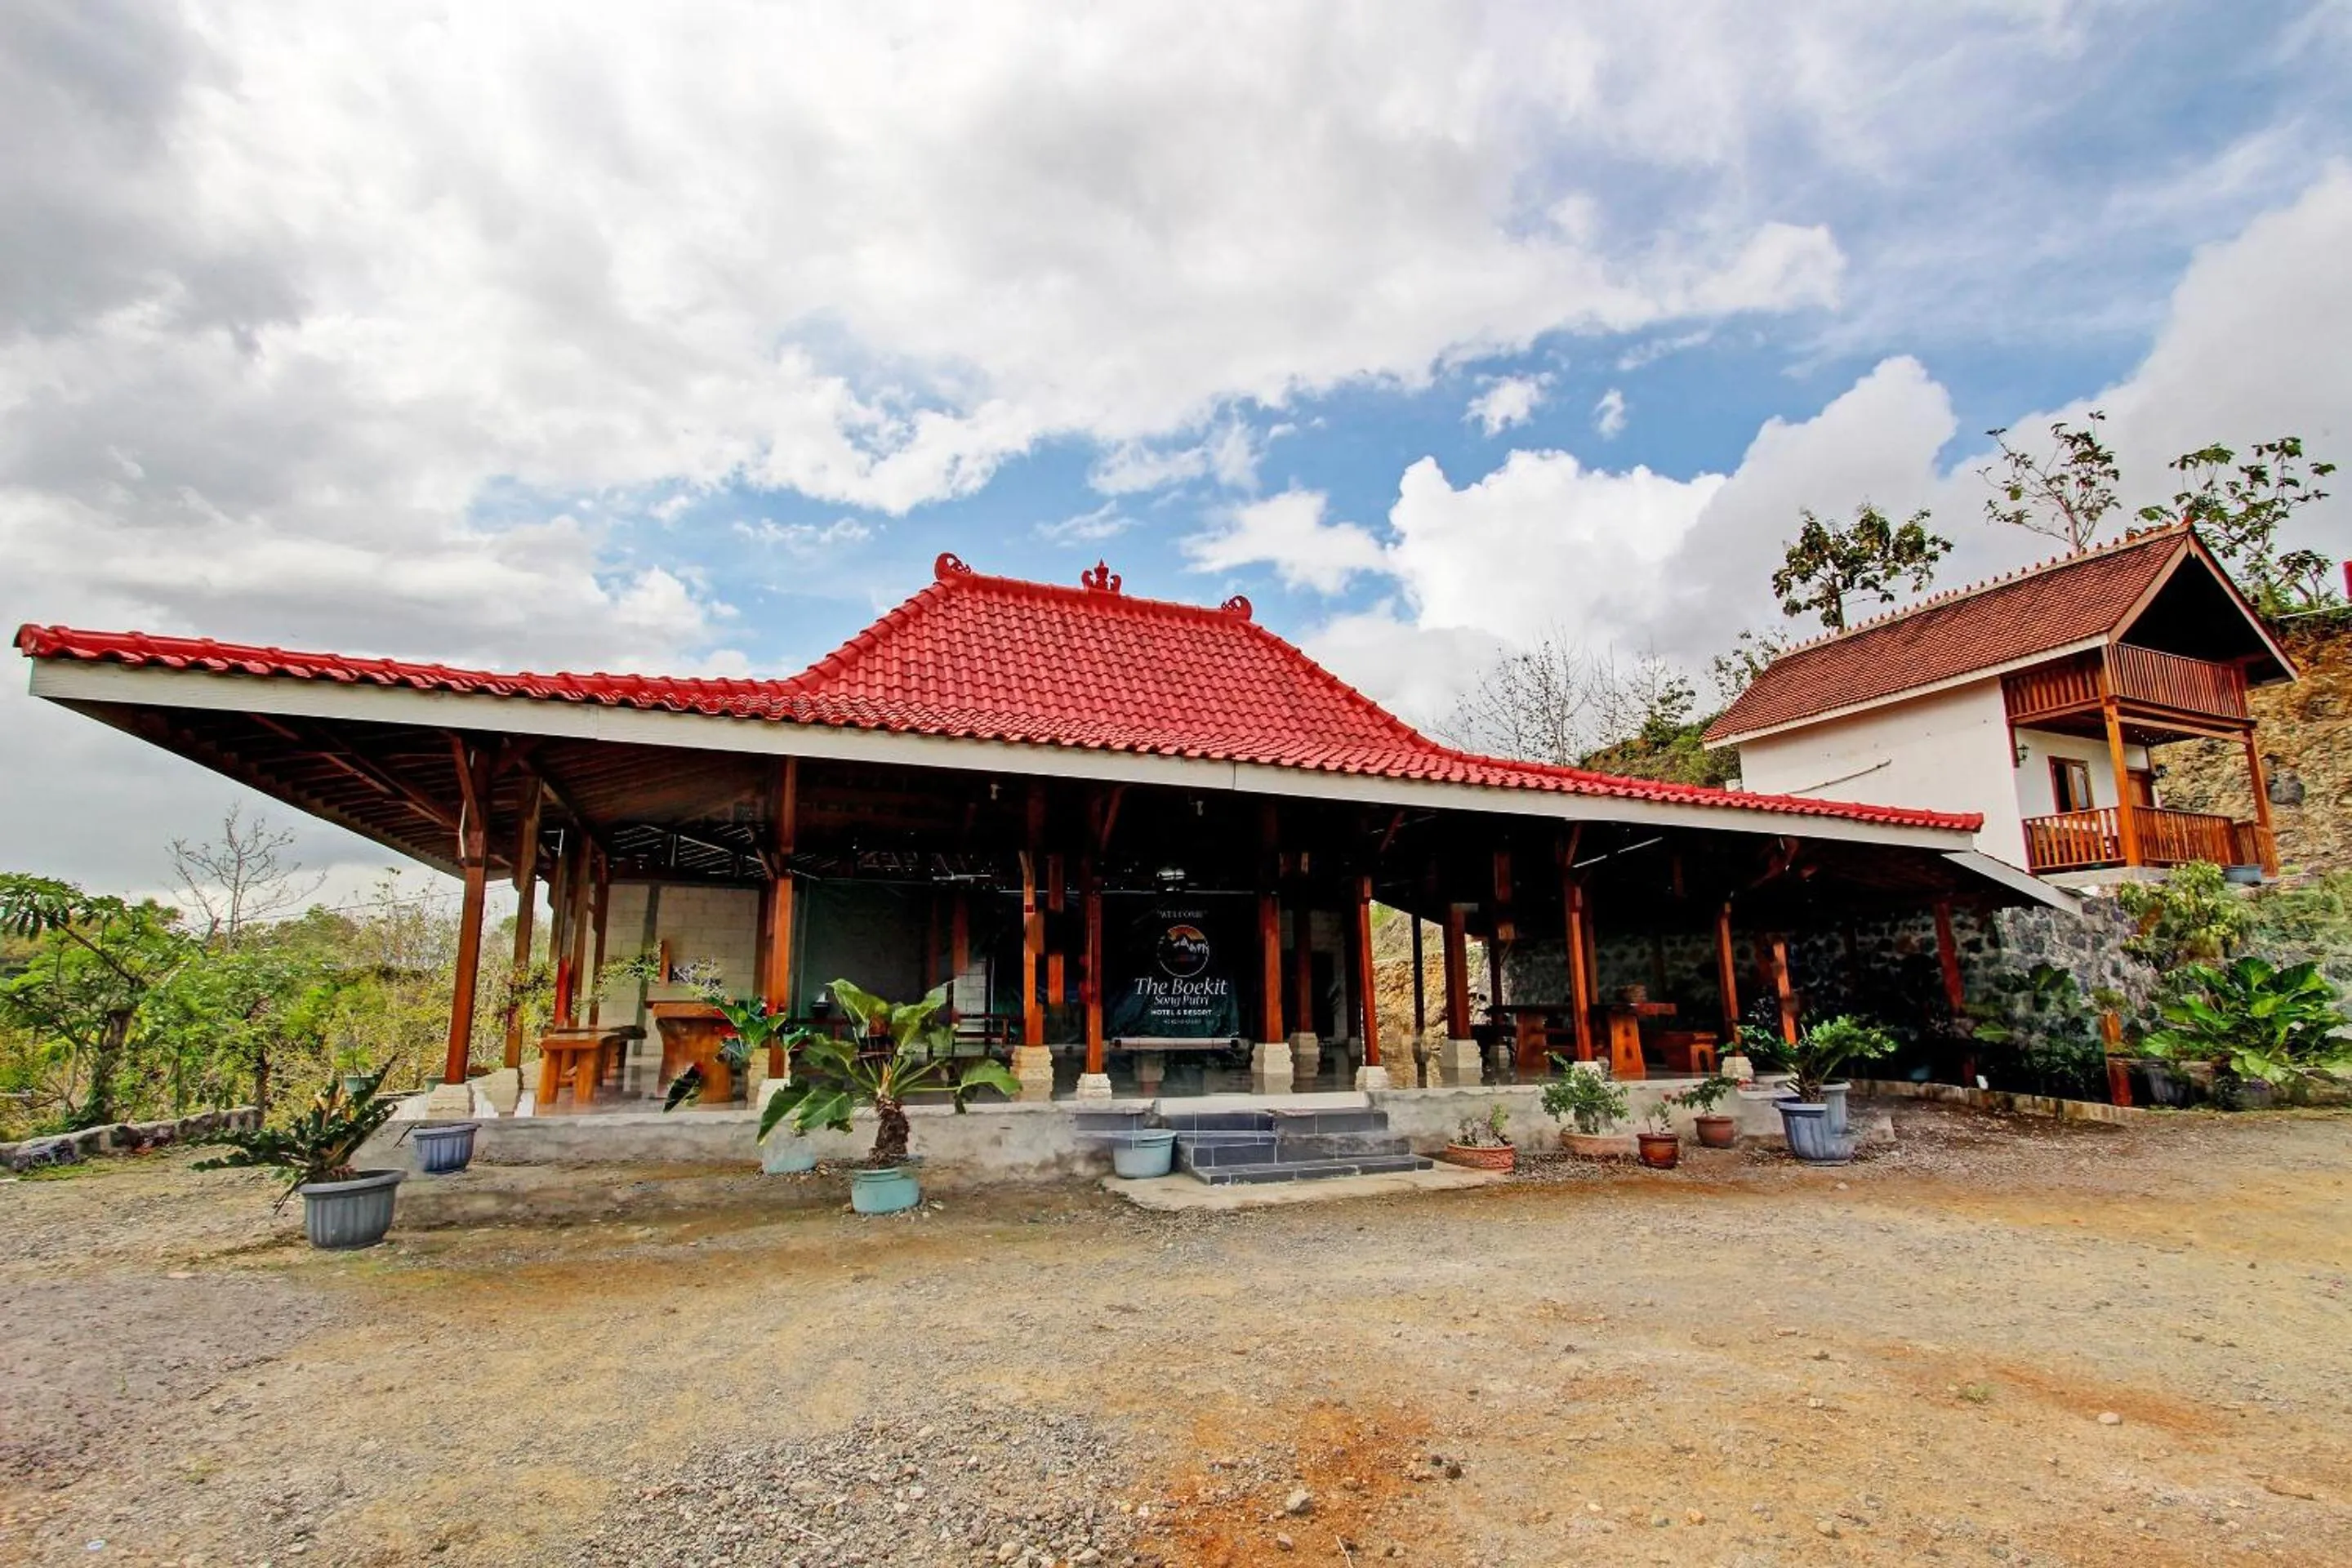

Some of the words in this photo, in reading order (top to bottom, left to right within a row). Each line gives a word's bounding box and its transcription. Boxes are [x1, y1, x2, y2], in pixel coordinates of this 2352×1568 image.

[1134, 976, 1169, 996] The
[1171, 977, 1228, 996] Boekit
[1153, 995, 1181, 1007] Song
